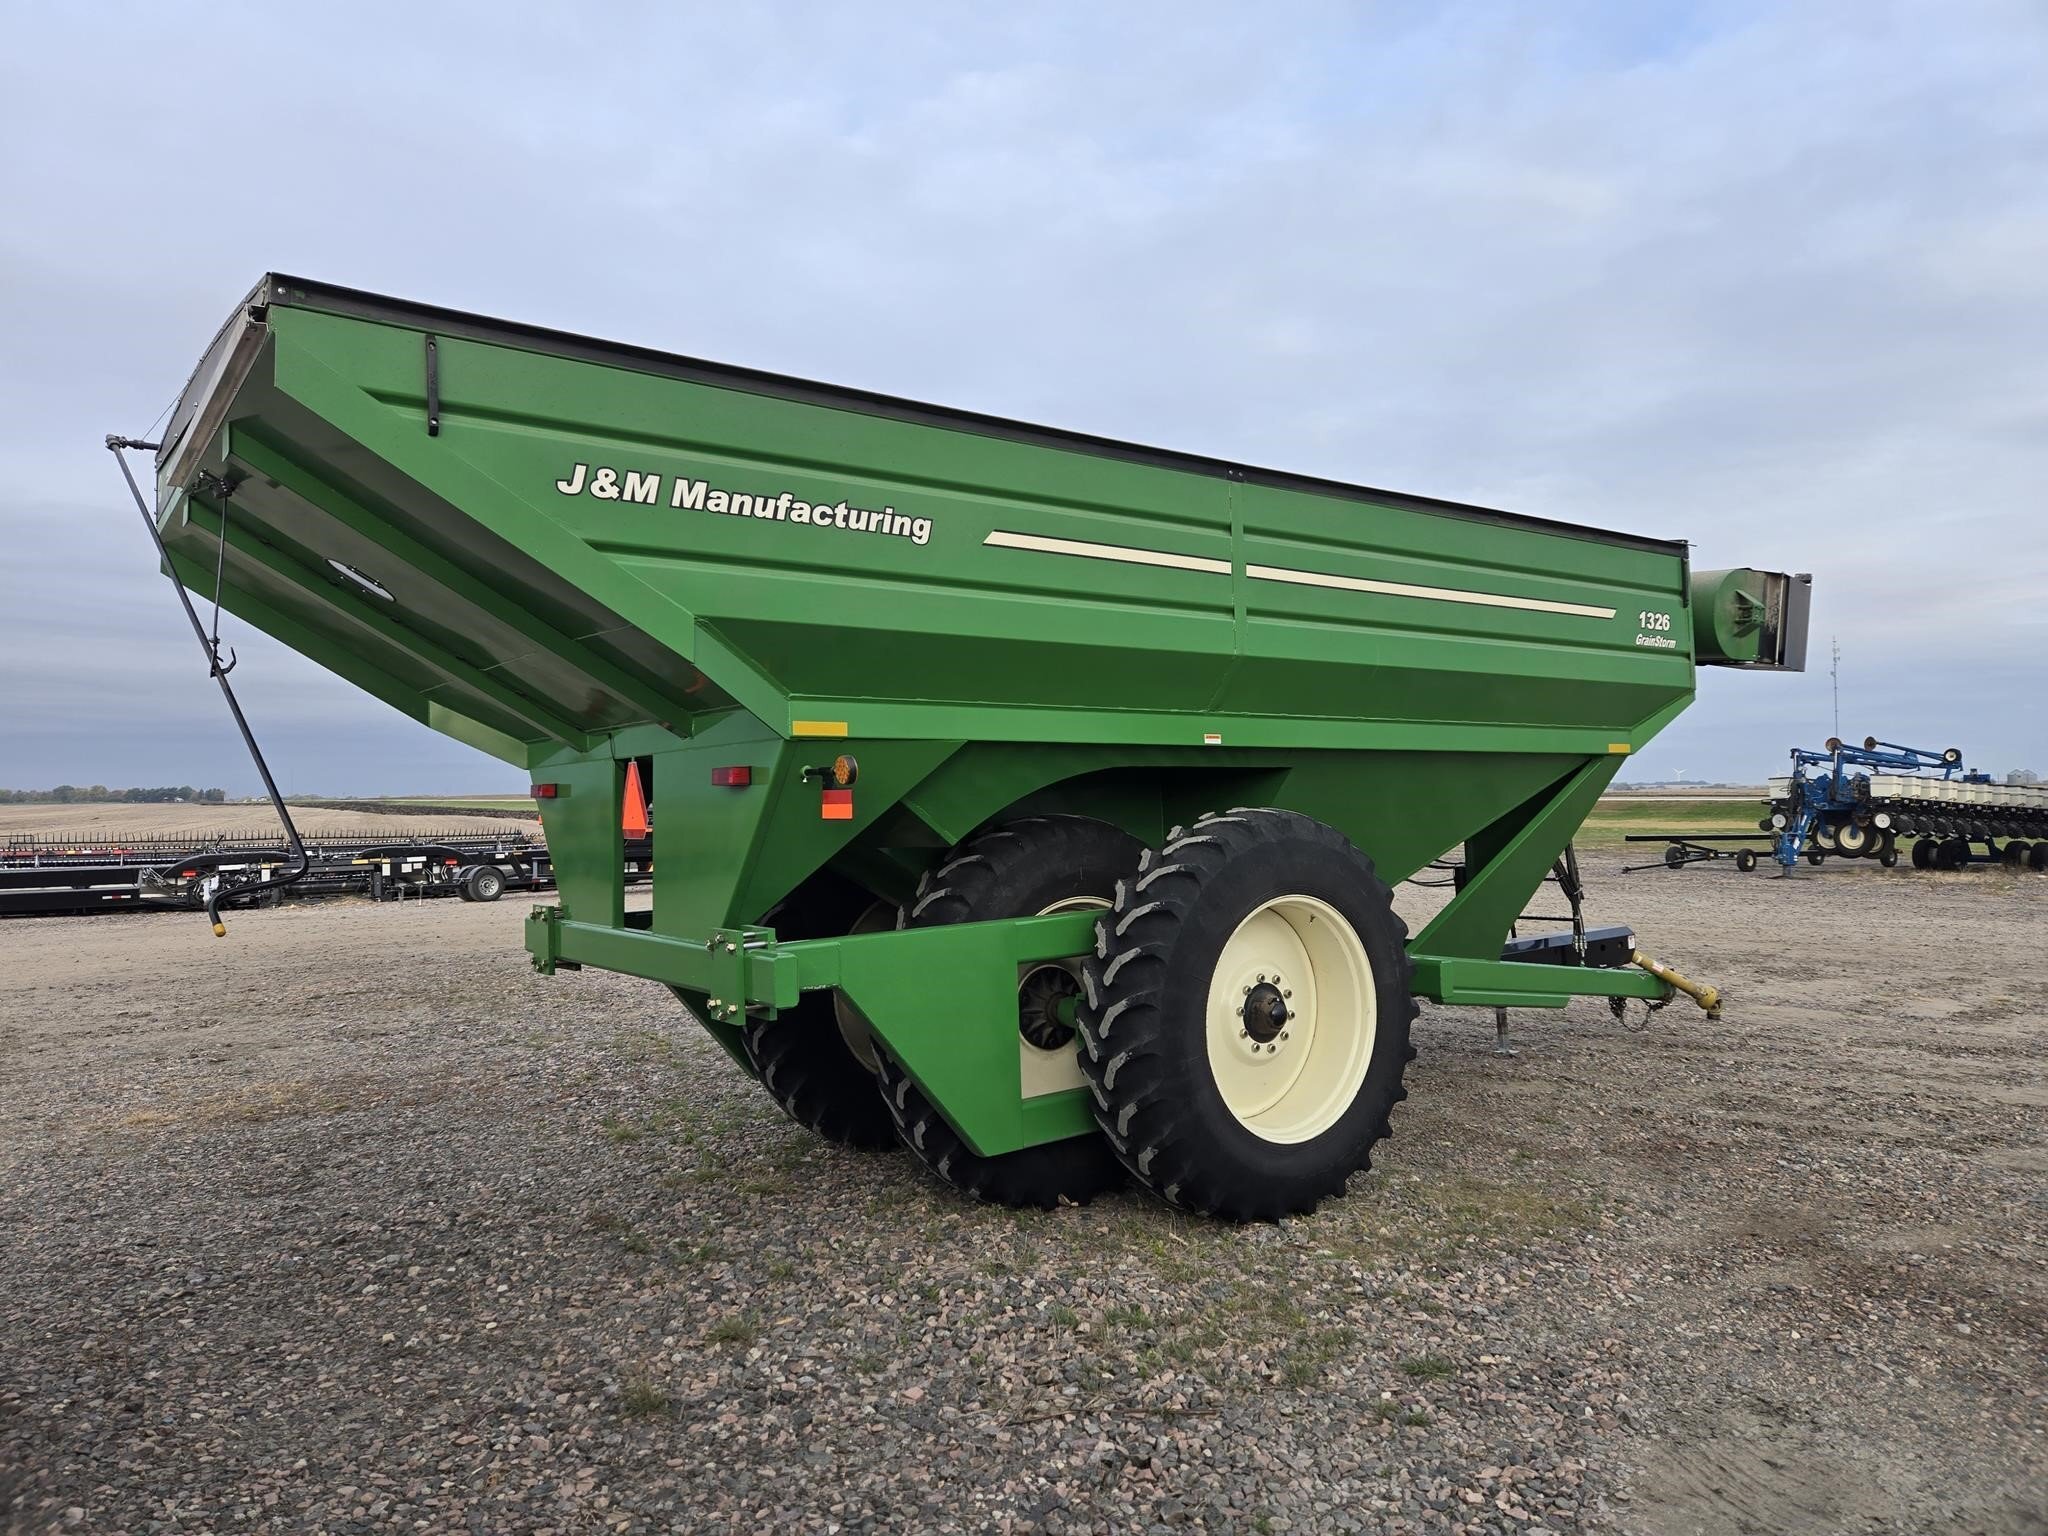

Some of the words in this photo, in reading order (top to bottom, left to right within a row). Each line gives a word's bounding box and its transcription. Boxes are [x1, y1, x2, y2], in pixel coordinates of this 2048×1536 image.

[556, 462, 662, 506] J&M
[670, 476, 934, 546] Manufacturing
[1639, 611, 1670, 631] 1326
[1635, 633, 1677, 649] GrainStorm
